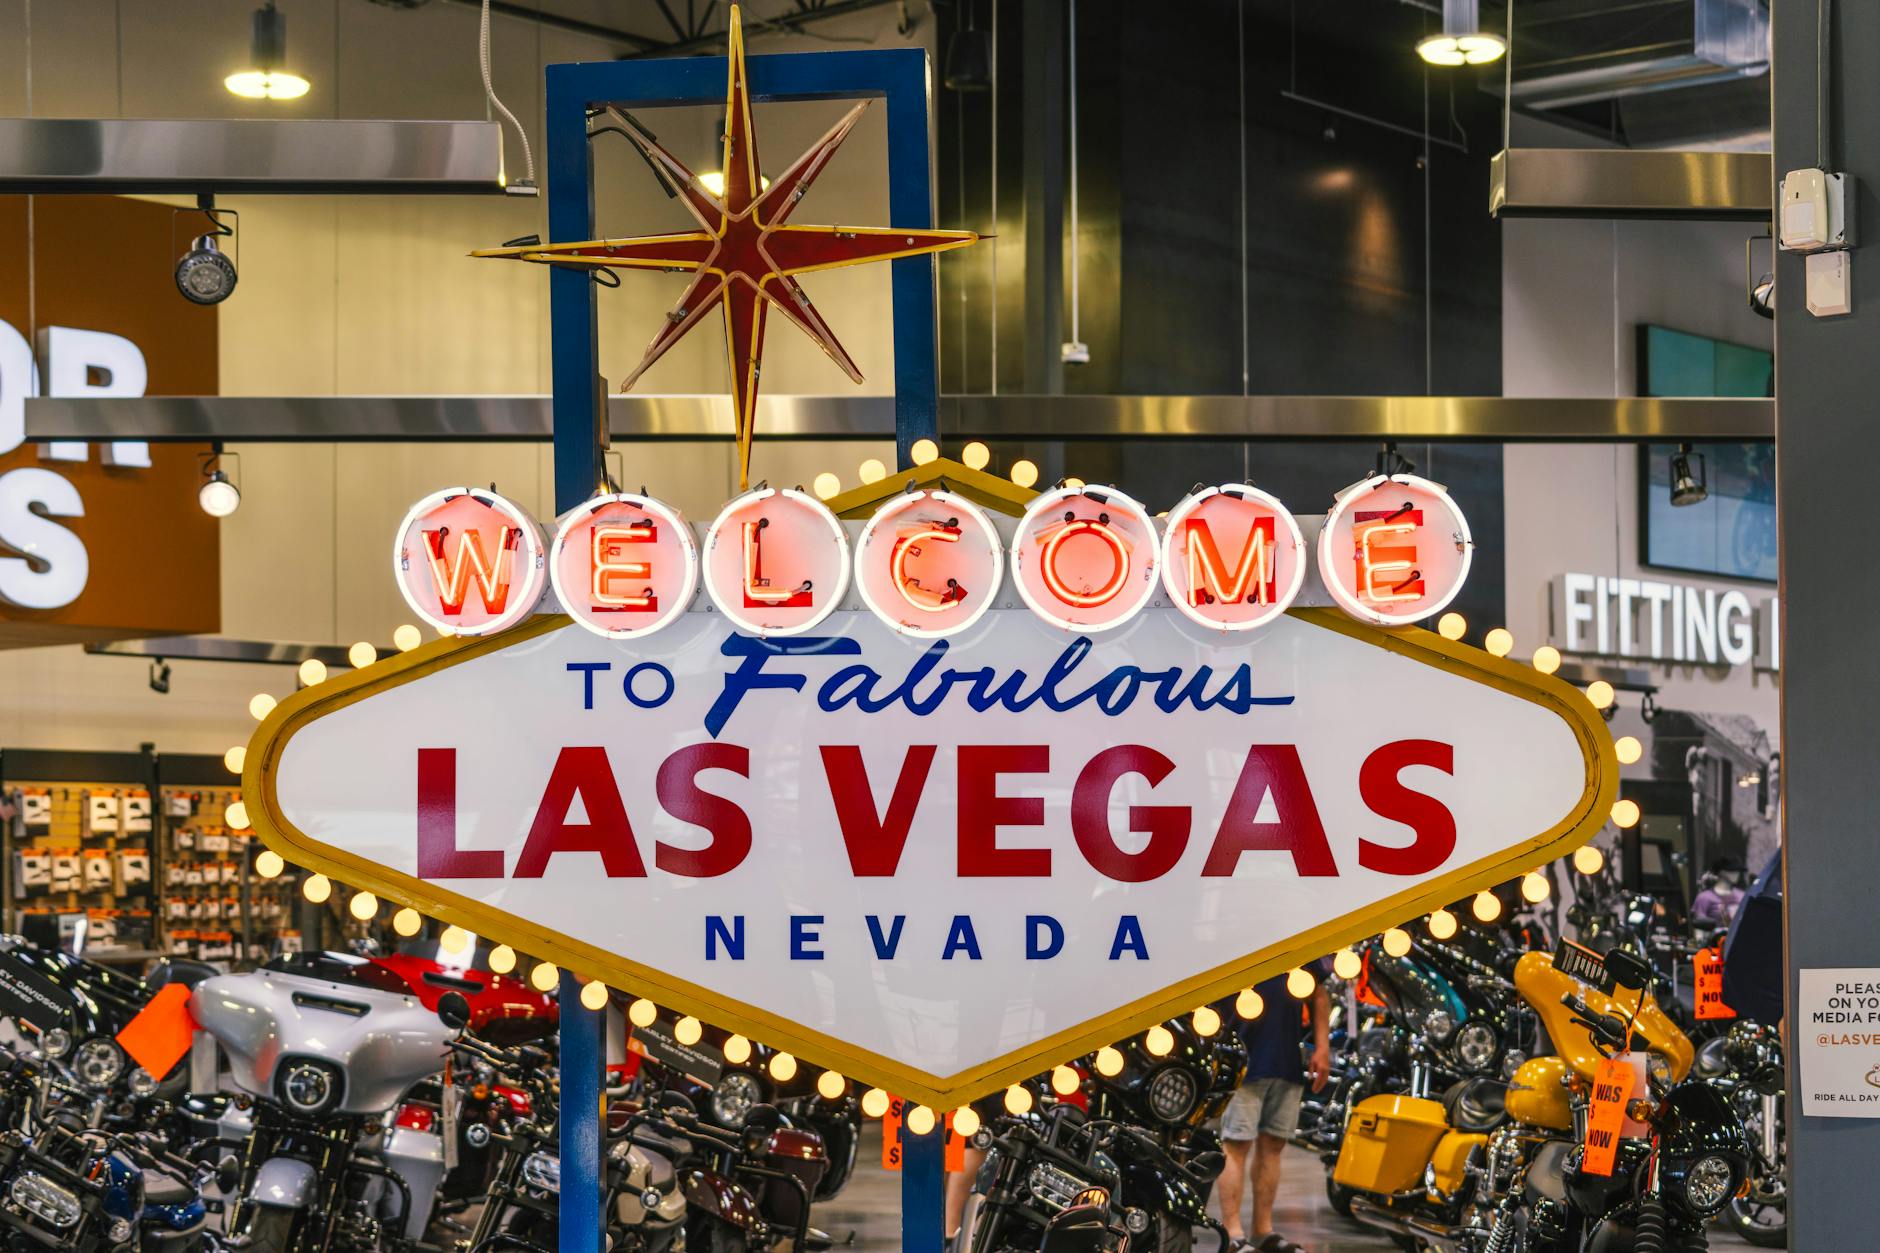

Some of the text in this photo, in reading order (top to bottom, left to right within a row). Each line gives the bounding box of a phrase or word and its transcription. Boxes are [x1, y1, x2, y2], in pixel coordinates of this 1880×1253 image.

[421, 508, 1427, 615] WELCOME
[1563, 572, 1753, 666] FITTING
[567, 631, 1294, 739] TO Fabulous
[418, 739, 1456, 882] LAS VEGAS
[706, 915, 1149, 961] NEVADA
[1828, 997, 1851, 1009] ON
[1813, 1012, 1862, 1023] MEDIA
[1596, 1083, 1622, 1103] WAS
[1814, 1093, 1879, 1102] RIDE ALL DAY
[1588, 1128, 1613, 1149] NOW
[889, 1146, 900, 1165] $
